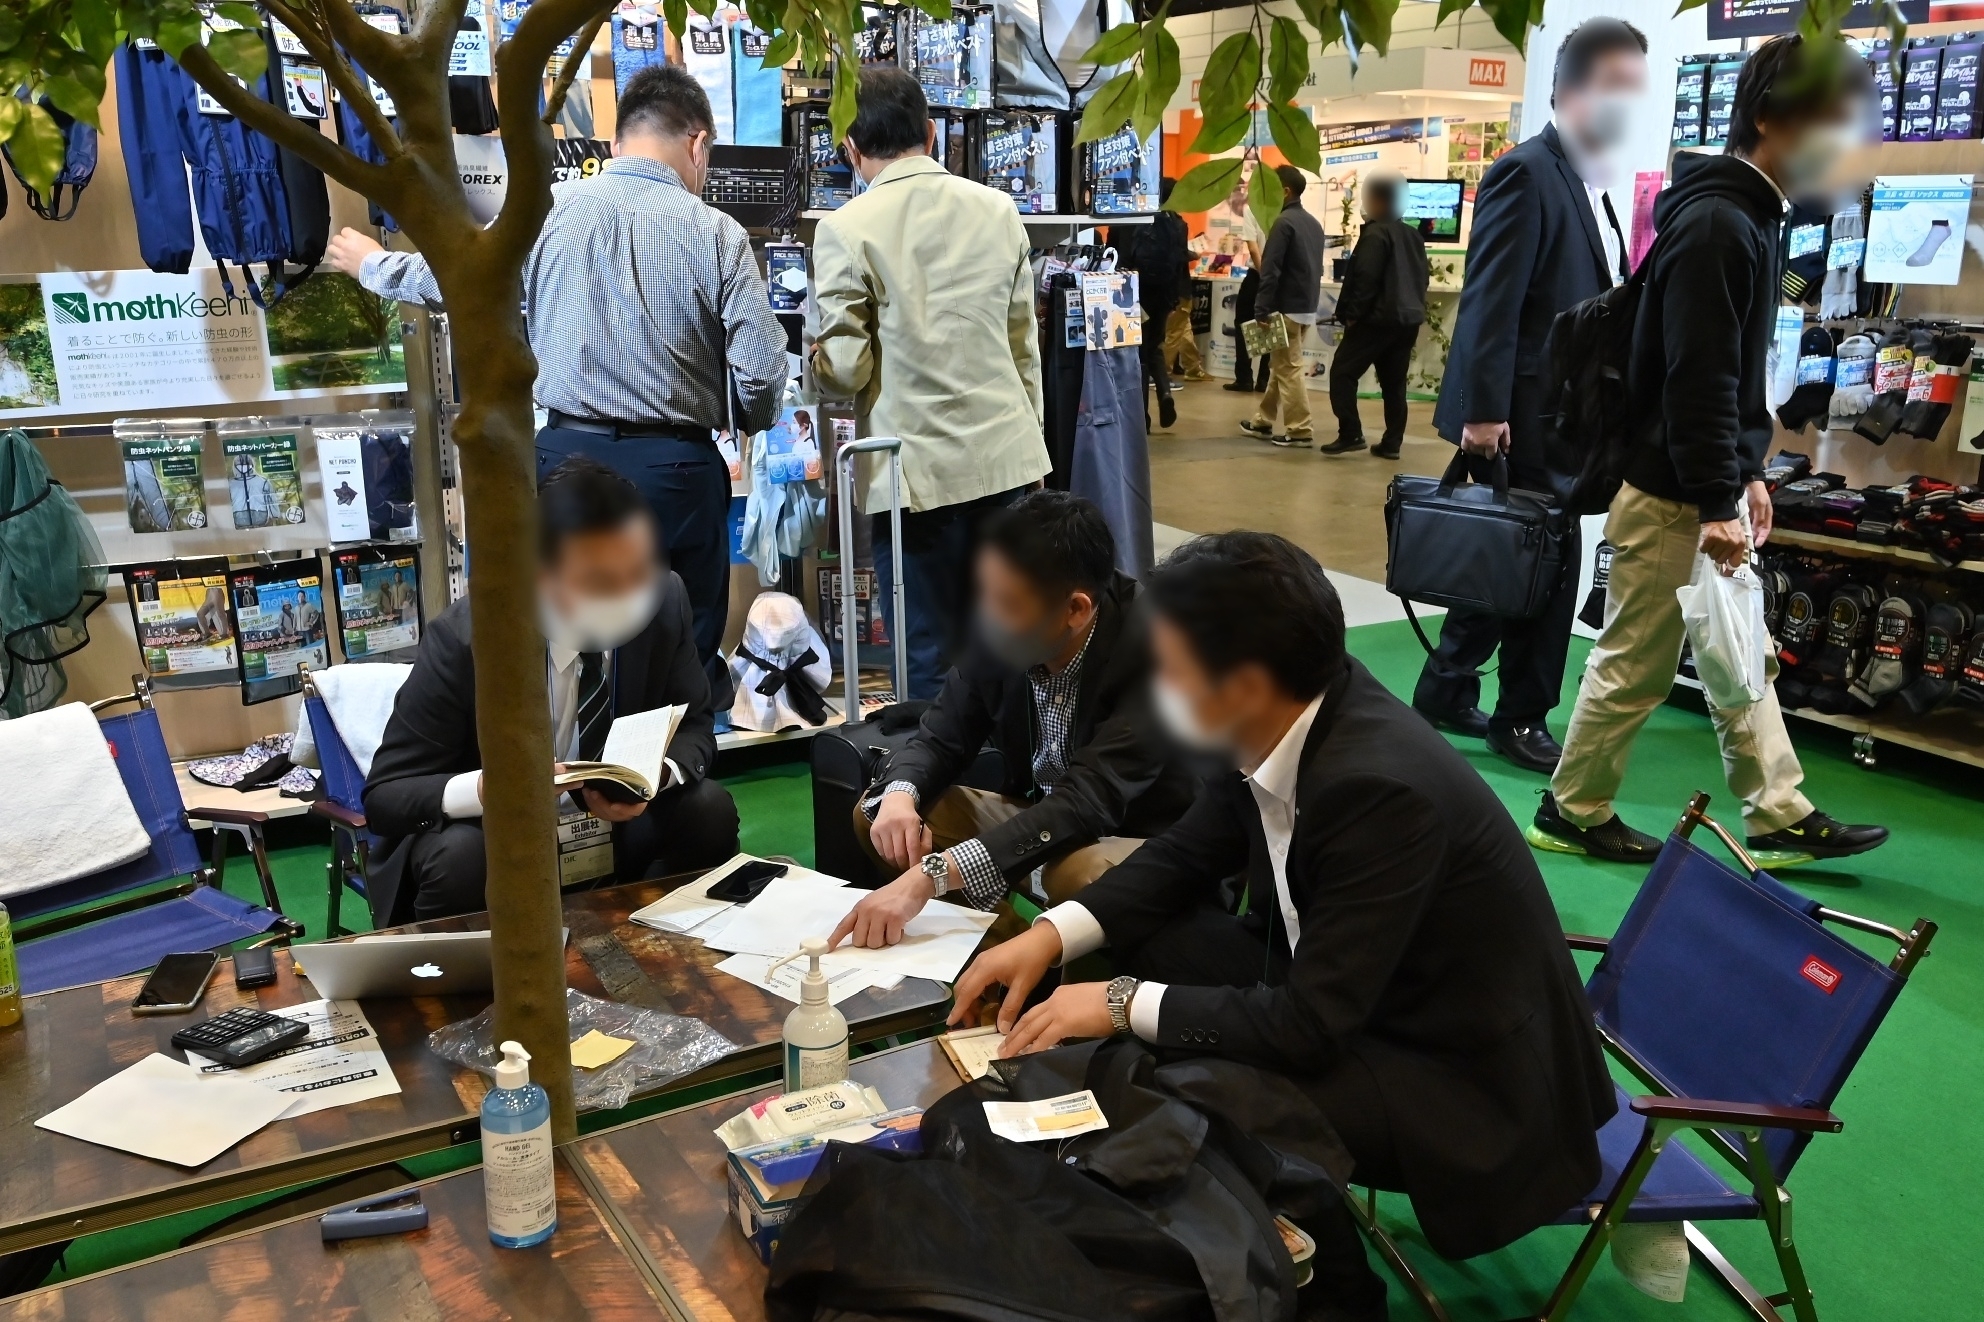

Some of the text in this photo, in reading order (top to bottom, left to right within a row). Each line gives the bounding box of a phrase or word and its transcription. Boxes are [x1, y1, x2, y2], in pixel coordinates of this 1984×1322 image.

[1471, 62, 1504, 83] MAX
[810, 132, 832, 148] 暑さ
[987, 132, 1025, 154] 暑さ対策
[1328, 130, 1356, 142] STRONG
[987, 141, 1049, 169] ファン付ベスト
[1098, 134, 1131, 158] 暑さ対策
[67, 326, 253, 348] 着ることで防ぐ。新しい防虫の形
[571, 818, 600, 835] 出展社
[574, 830, 597, 840] Exhibitor
[1808, 963, 1829, 982] Coleman
[805, 1090, 840, 1107] 除菌
